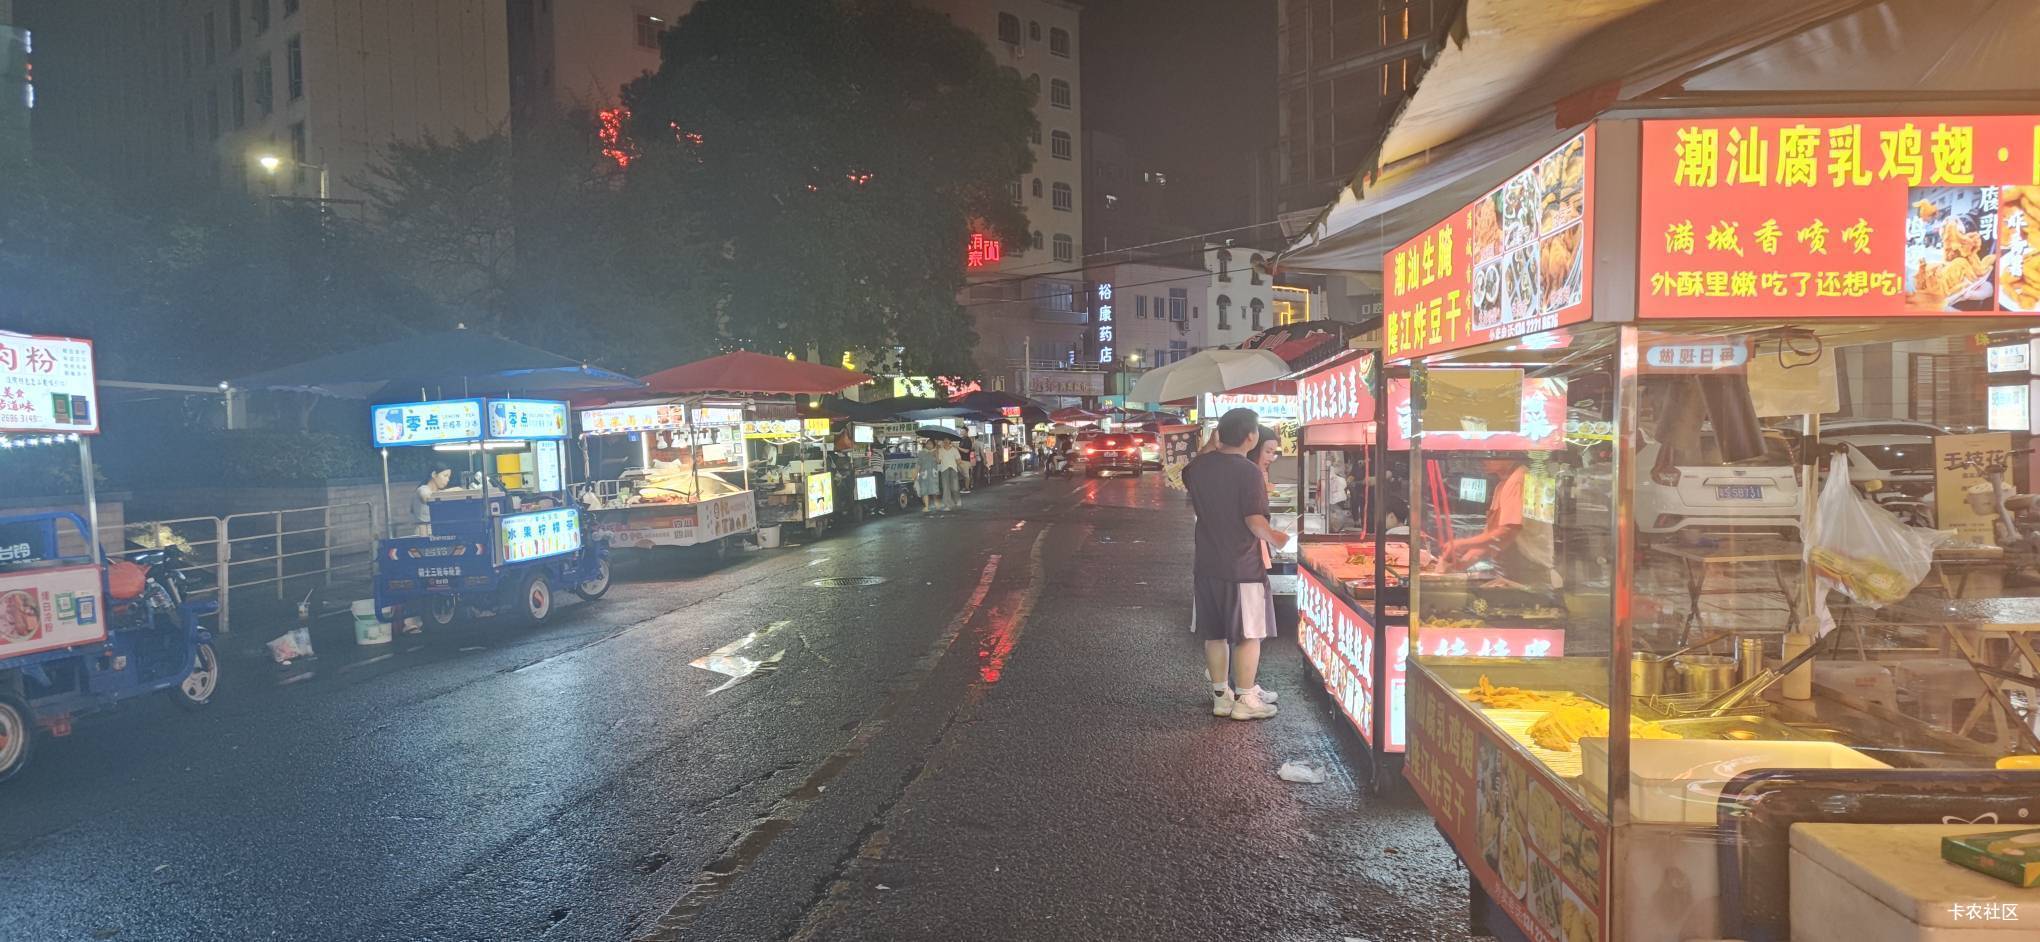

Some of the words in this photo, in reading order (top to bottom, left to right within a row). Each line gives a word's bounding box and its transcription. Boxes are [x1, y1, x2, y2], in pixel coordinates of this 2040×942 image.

[1673, 122, 2040, 187] 潮汕腐乳鸡翅·
[1664, 218, 1875, 257] 满城香喷喷
[1979, 186, 1998, 241] 腐乳
[1394, 224, 1454, 297] 潮汕生腌
[1098, 283, 1113, 364] 裕康药店
[1387, 289, 1462, 357] 隆江炸豆干
[406, 413, 440, 432] 零点
[508, 519, 574, 541] 水果柠檬茶
